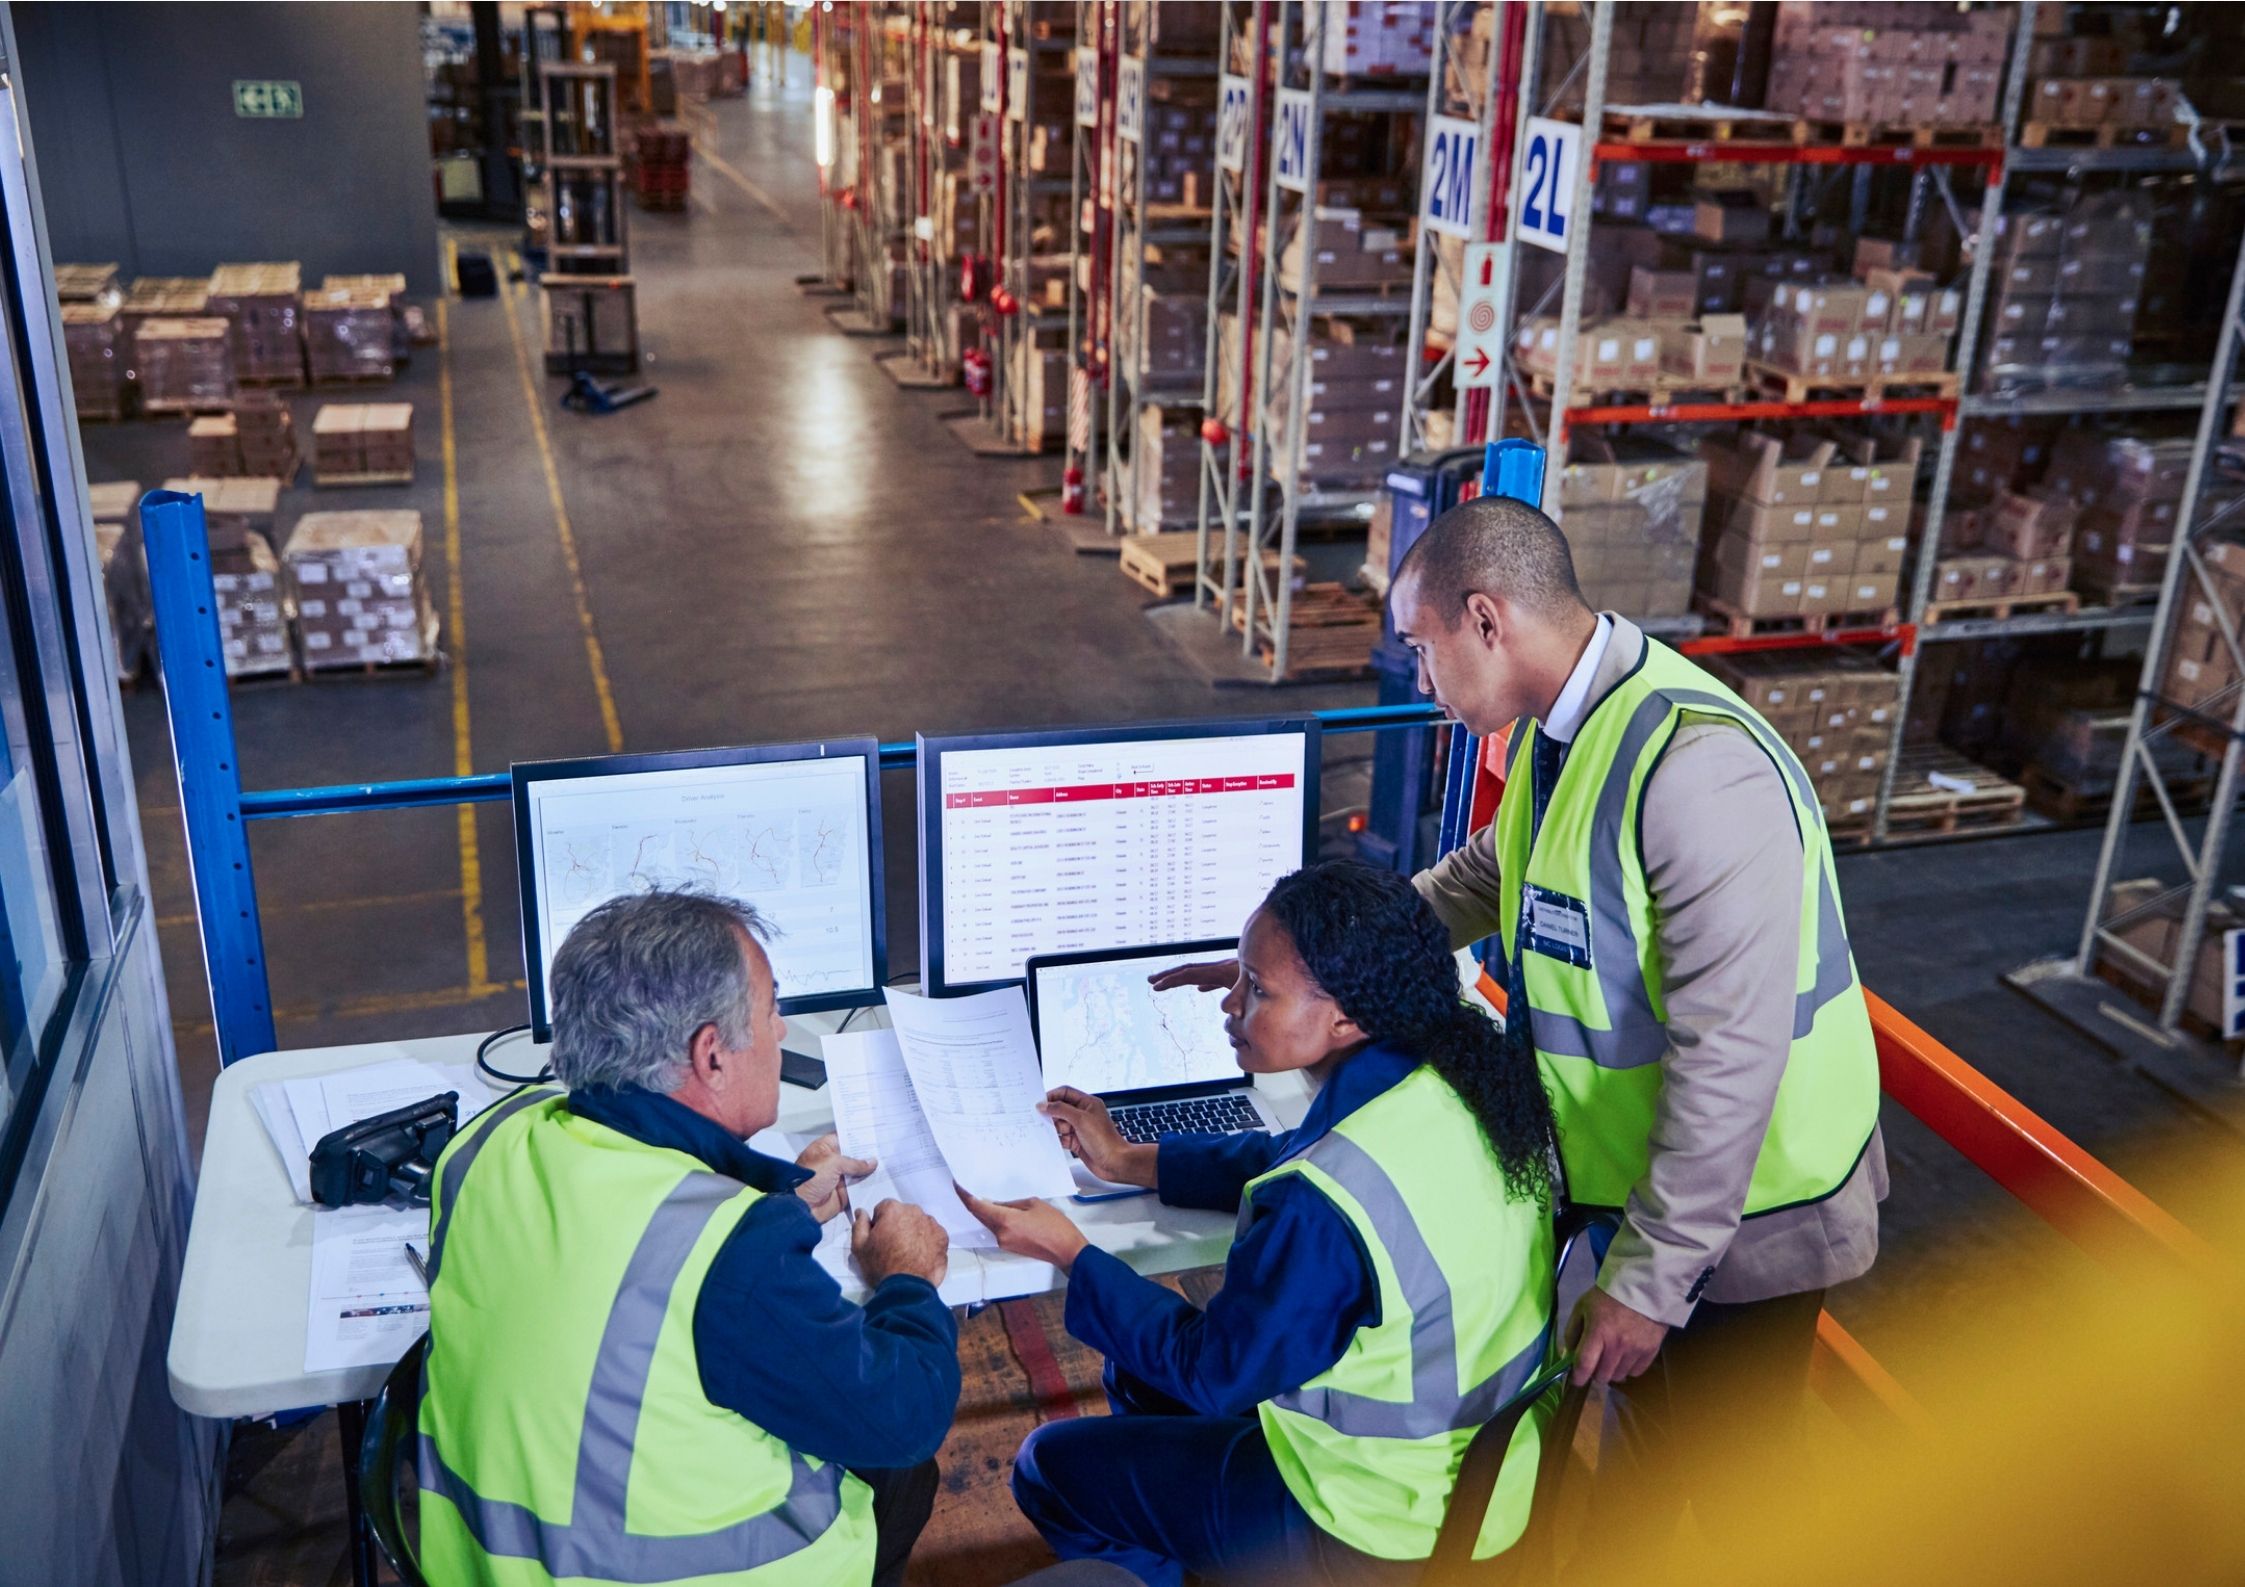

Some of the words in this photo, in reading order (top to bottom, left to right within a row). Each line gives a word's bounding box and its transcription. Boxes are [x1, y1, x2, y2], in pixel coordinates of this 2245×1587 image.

[1278, 103, 1308, 179] 2N
[1429, 131, 1475, 226] 2M
[1522, 134, 1566, 237] 2L
